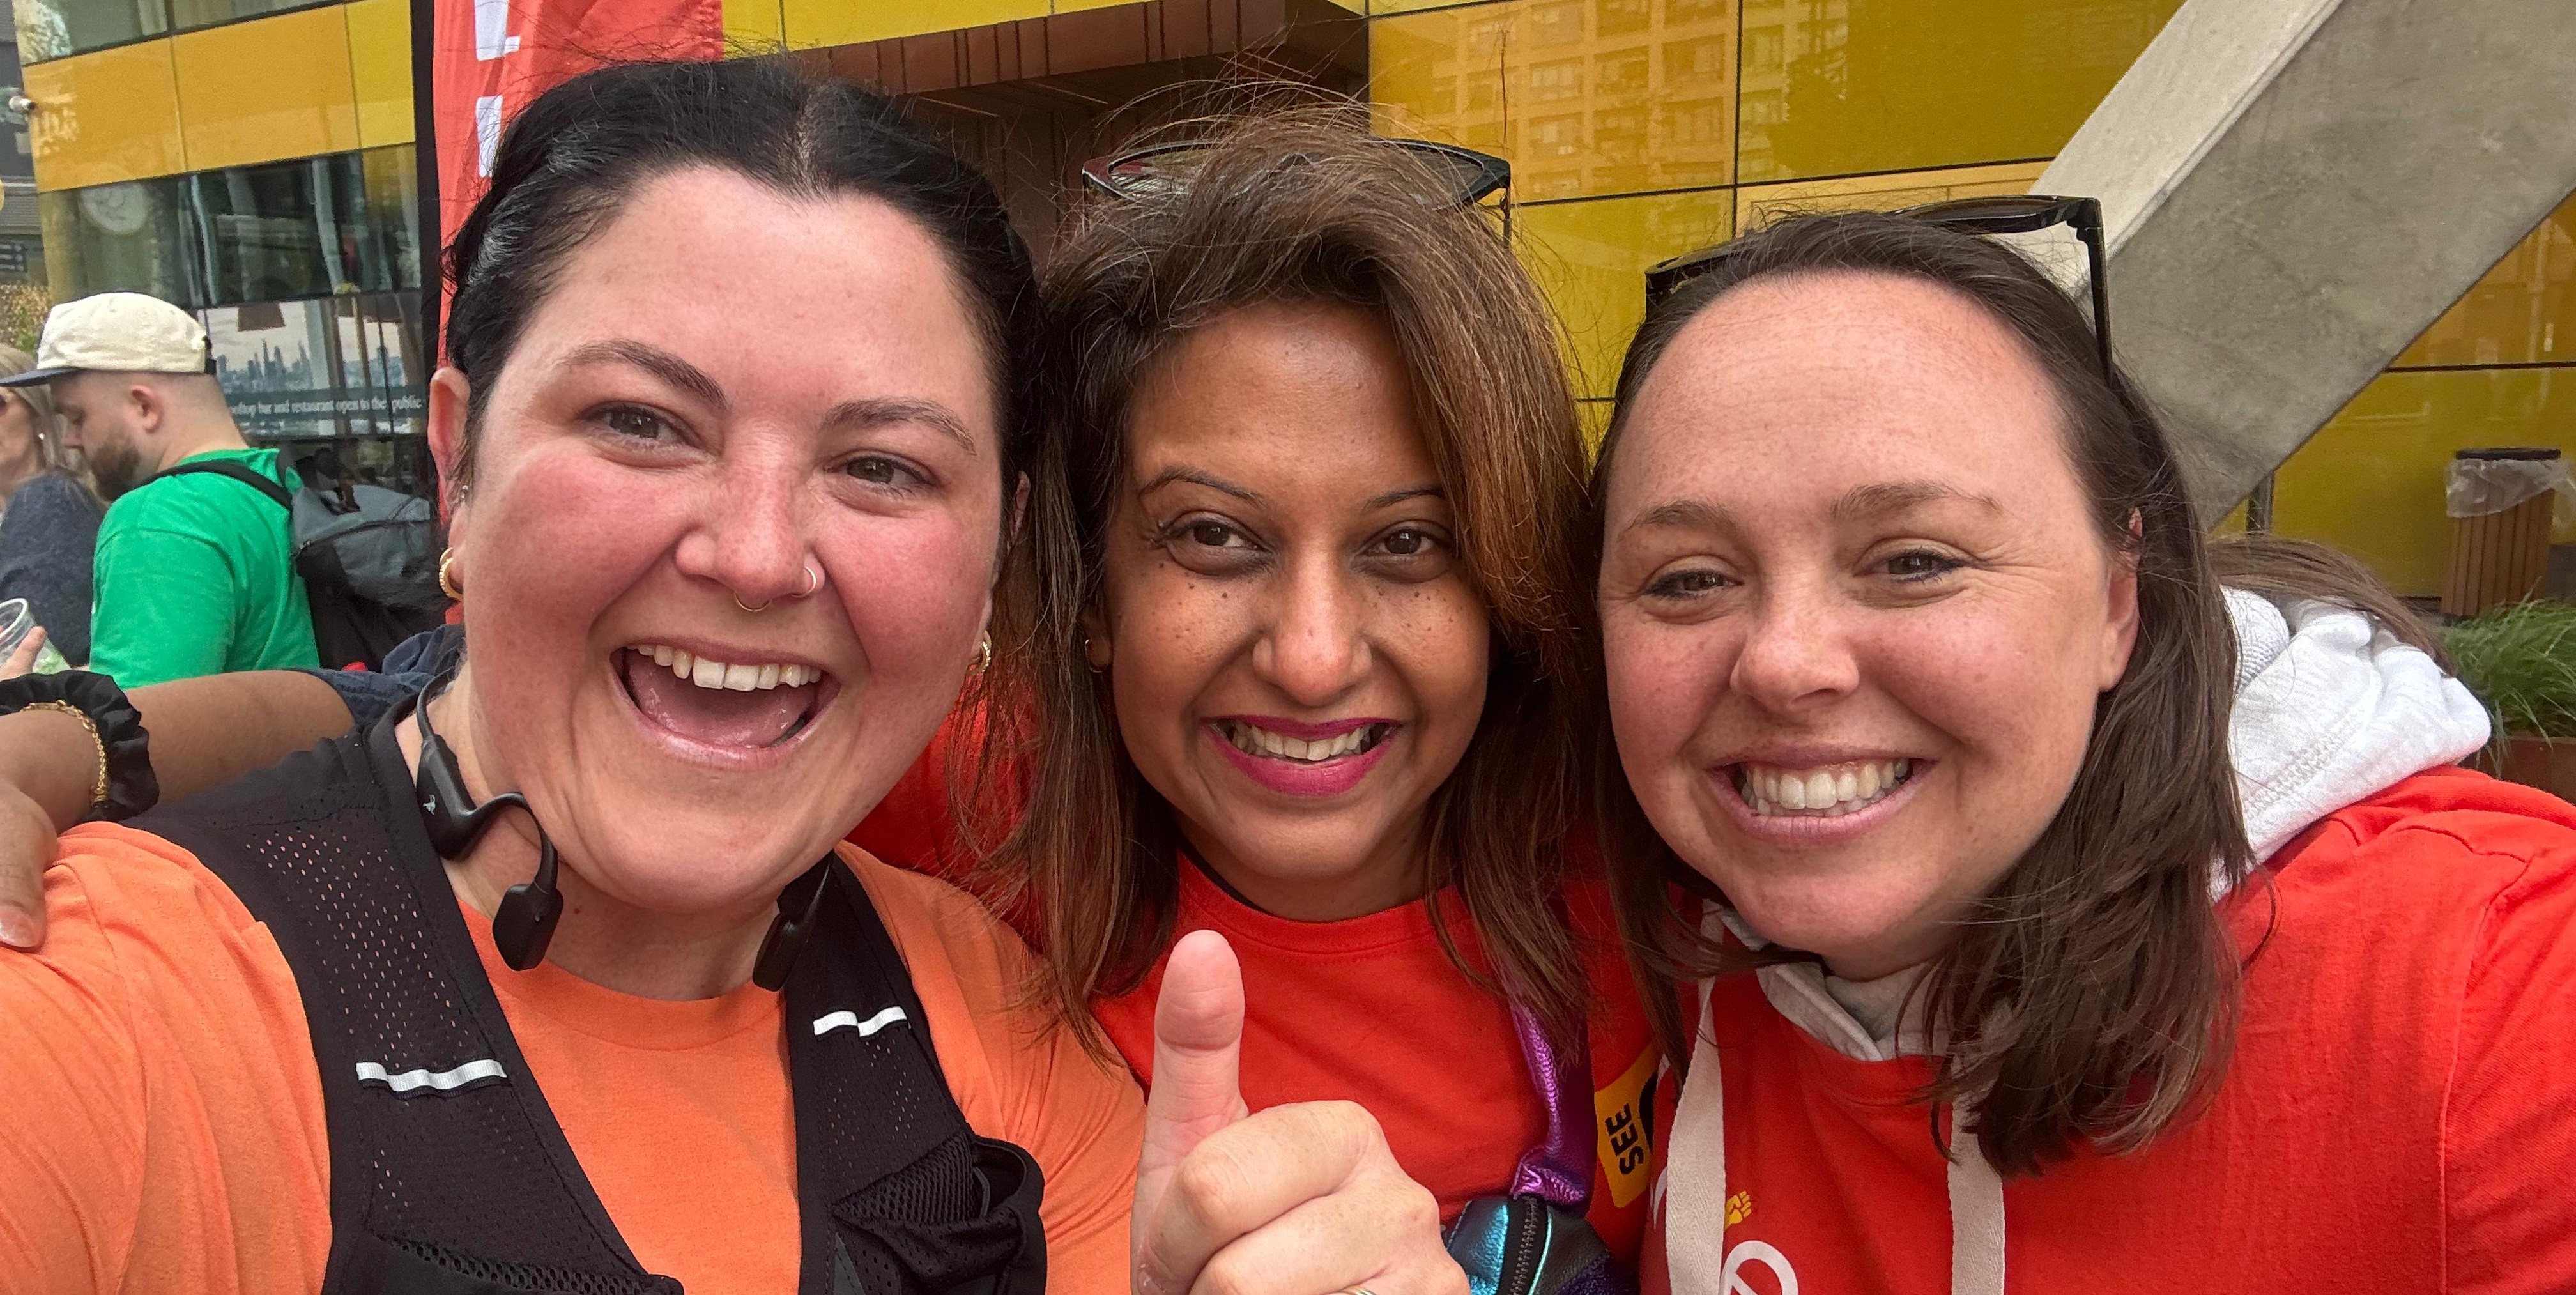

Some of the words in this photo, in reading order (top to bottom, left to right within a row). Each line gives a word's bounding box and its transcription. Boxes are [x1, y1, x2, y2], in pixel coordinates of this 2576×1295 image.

[291, 399, 334, 413] restaurant
[336, 400, 358, 414] open
[371, 395, 387, 410] the
[392, 394, 422, 413] public
[1604, 1102, 1644, 1175] SEE
